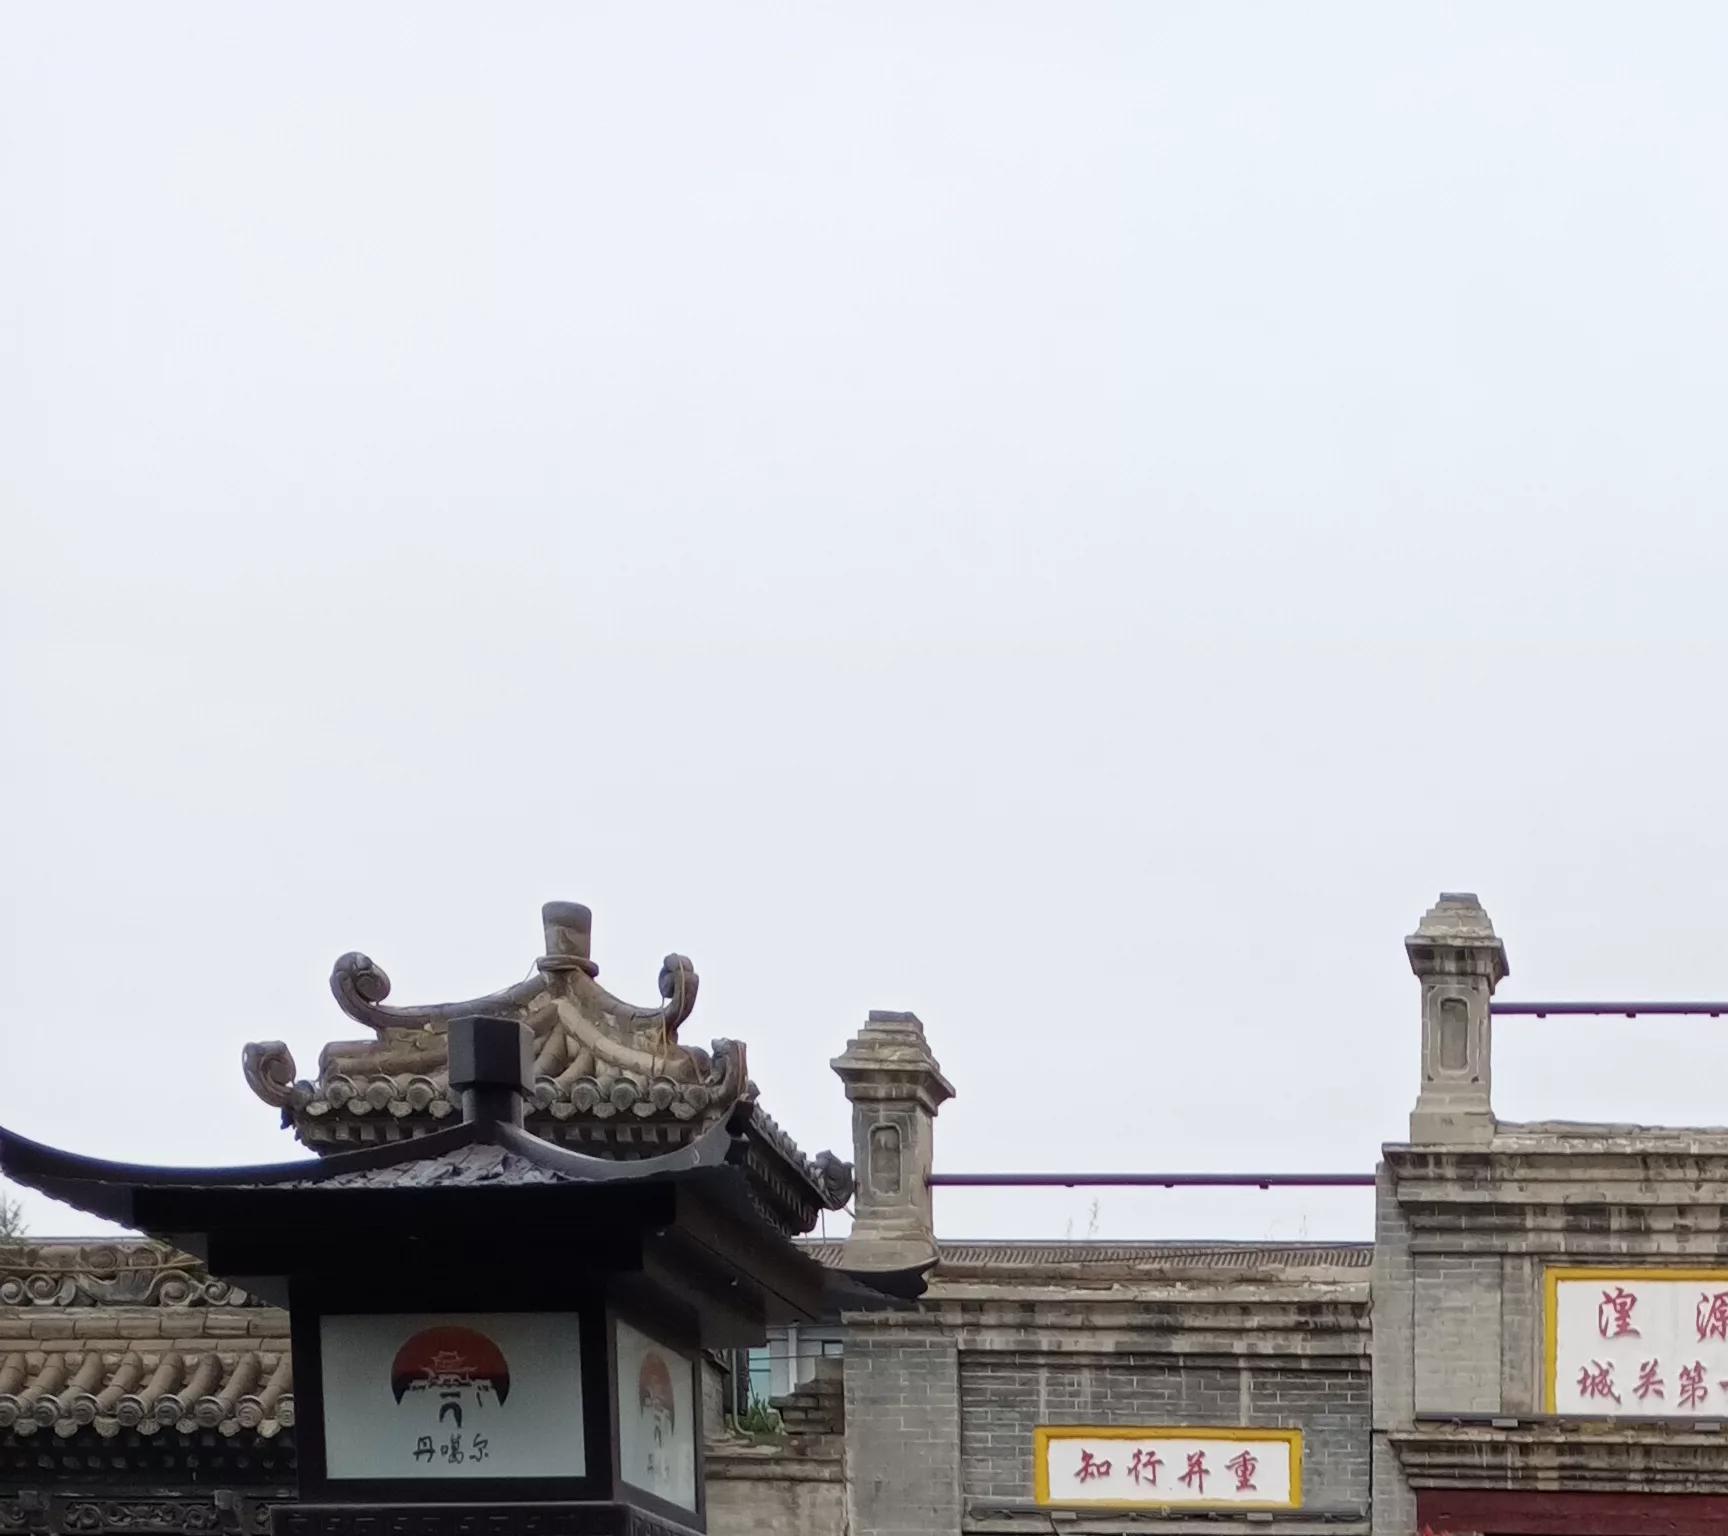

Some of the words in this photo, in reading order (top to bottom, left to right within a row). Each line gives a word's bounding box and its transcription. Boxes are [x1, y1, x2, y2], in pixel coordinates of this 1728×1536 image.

[413, 1434, 489, 1464] 丹噶尔
[1074, 1448, 1259, 1495] 知行并重
